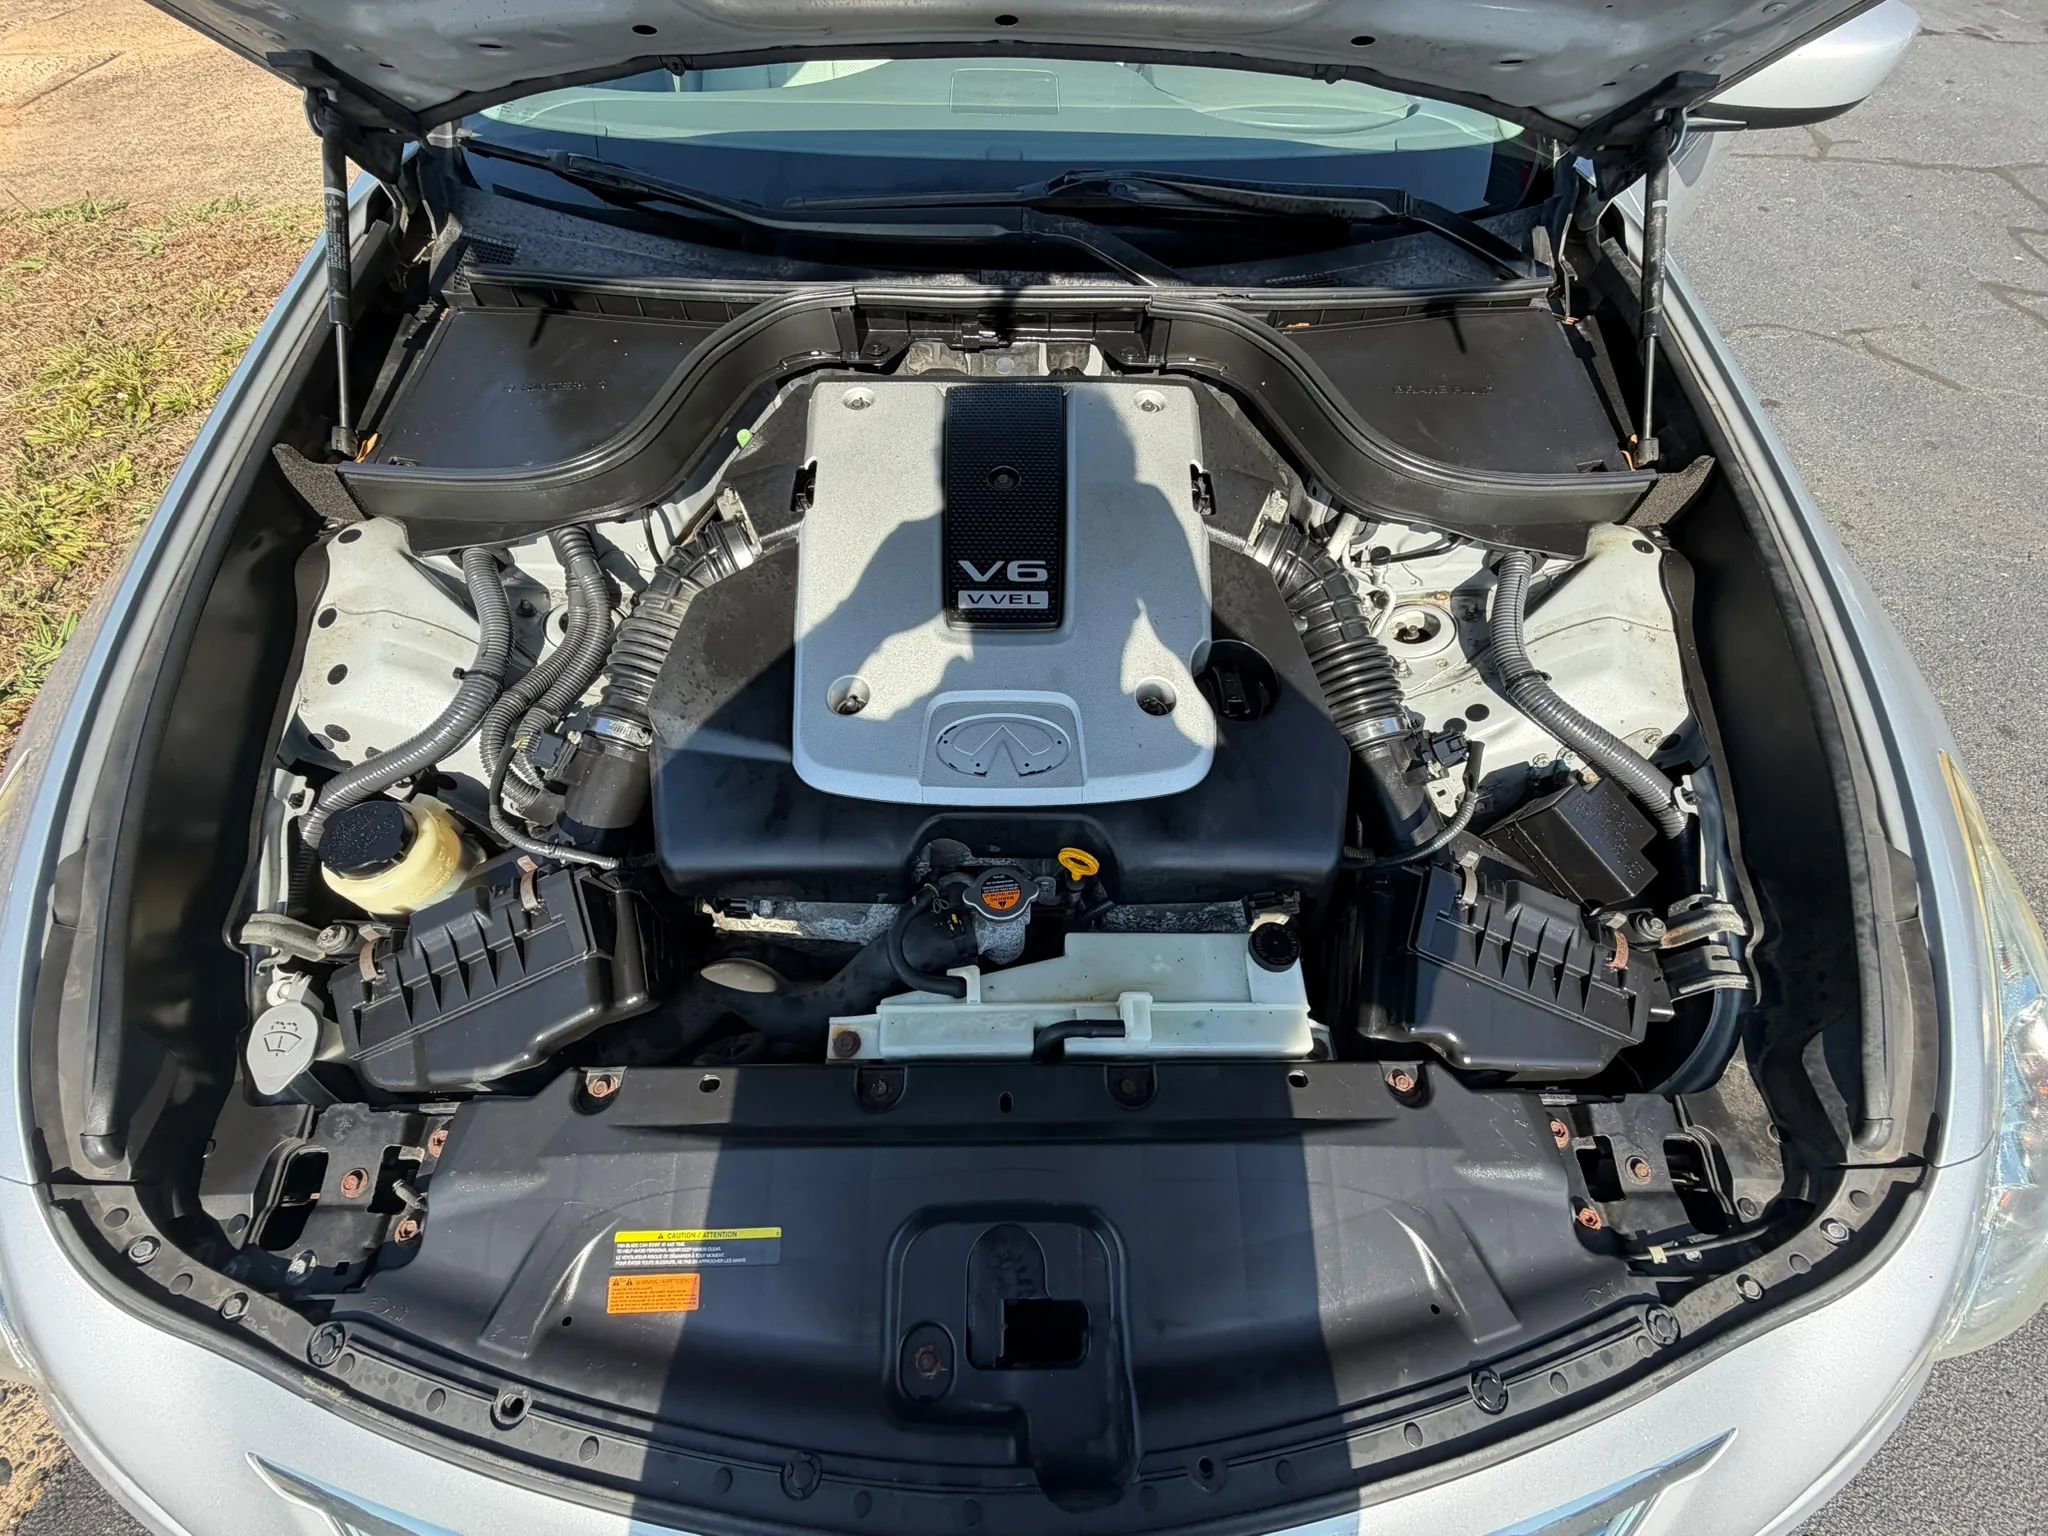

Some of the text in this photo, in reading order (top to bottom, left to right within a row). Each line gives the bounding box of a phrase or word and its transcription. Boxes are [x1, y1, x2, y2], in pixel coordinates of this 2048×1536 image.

[958, 560, 1048, 582] V6
[967, 594, 1041, 605] VVEL
[703, 1231, 738, 1239] ATTENTION
